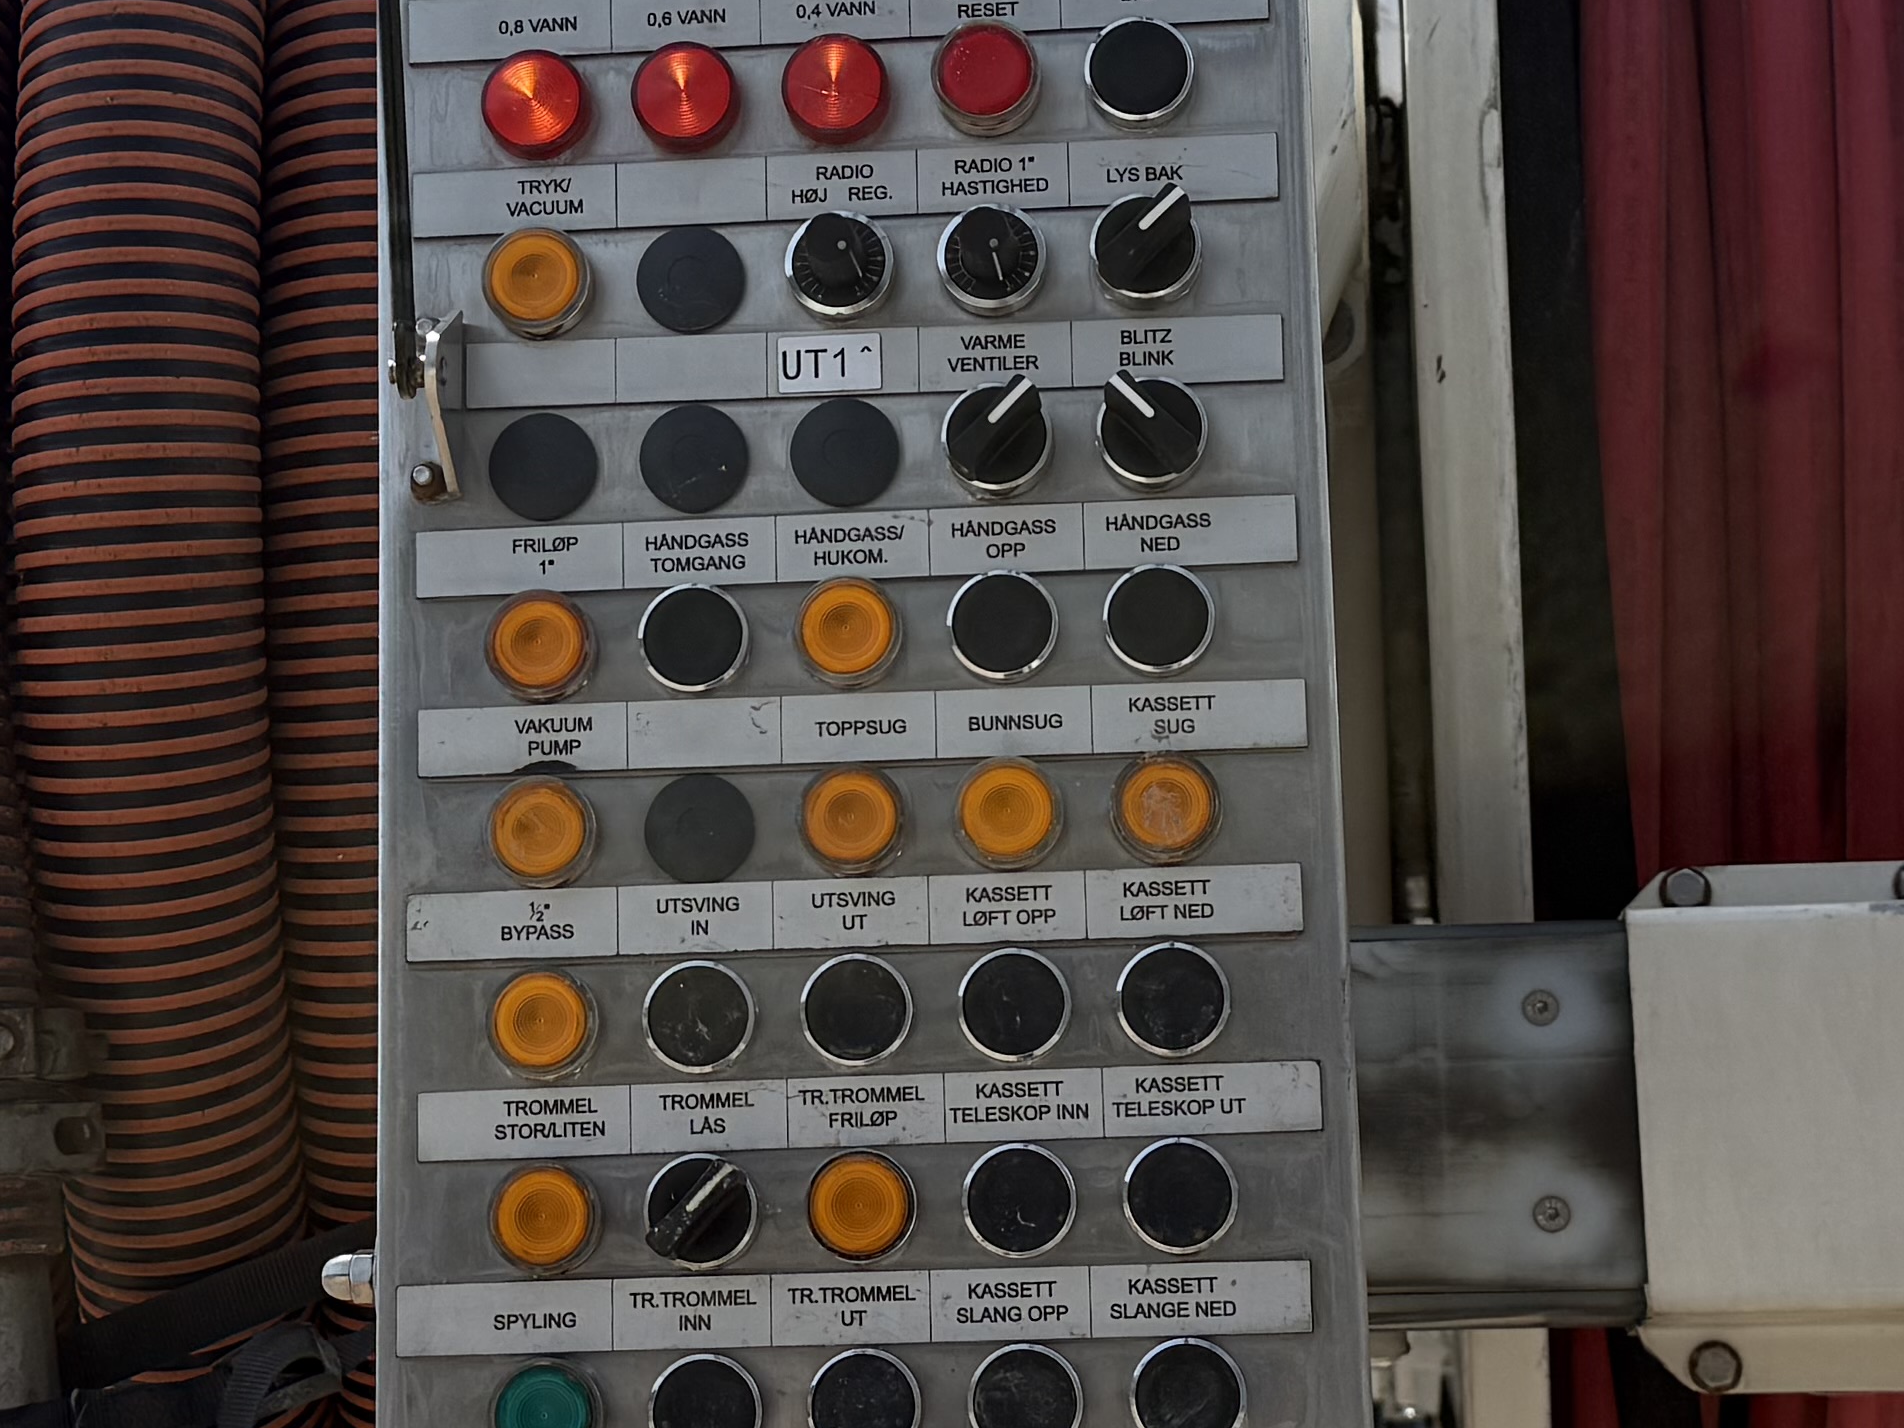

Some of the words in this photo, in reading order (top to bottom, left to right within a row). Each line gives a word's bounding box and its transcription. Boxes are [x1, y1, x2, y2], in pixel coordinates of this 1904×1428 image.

[648, 12, 671, 28] 0,6
[677, 8, 725, 24] VANN
[796, 4, 822, 20] 0,4
[826, 1, 875, 17] VANN
[958, 1, 1019, 18] RESET
[499, 20, 523, 36] 0,8
[528, 16, 577, 32] VANN
[816, 164, 873, 180] RADIO
[955, 158, 1012, 174] RADIO
[1107, 167, 1139, 183] LYS
[1145, 165, 1183, 181] BAK
[517, 178, 571, 194] TRYK/
[792, 188, 827, 204] HØJ
[849, 185, 892, 201] REG.
[942, 178, 1048, 196] HASTIGHED
[506, 199, 583, 217] VACUUM
[961, 334, 1025, 350] VARME
[1121, 329, 1172, 345] BLITZ
[948, 355, 1039, 372] VENTILER
[1120, 350, 1173, 366] BLINK
[952, 519, 1056, 538] HÅNDGASS
[1106, 513, 1211, 531] HÅNDGASS
[646, 532, 748, 551] HÅNDGASS
[795, 525, 904, 544] HÅNDGASS/
[513, 537, 578, 554] FRILØP
[986, 543, 1025, 558] OPP
[1141, 536, 1180, 552] NED
[650, 555, 745, 573] TOMGANG
[814, 548, 887, 566] HUKOM.
[1129, 695, 1216, 712] KASSETT
[515, 717, 592, 734] VAKUUM
[815, 719, 906, 737] TOPPSUG
[969, 714, 1062, 731] BUNNSUG
[1154, 719, 1195, 734] SUG
[528, 739, 581, 756] PUMP
[966, 885, 1052, 903] KASSETT
[1123, 880, 1211, 898] KASSETT
[657, 897, 739, 914] UTSVING
[812, 891, 895, 908] UTSVING
[963, 910, 1011, 926] LØFT
[1016, 909, 1056, 925] OPP
[1121, 905, 1168, 921] LØFT
[1174, 903, 1214, 919] NED
[692, 920, 708, 935] IN
[843, 914, 867, 930] UT
[501, 924, 574, 941] BYPASS
[976, 1081, 1064, 1099] KASSETT
[1136, 1075, 1224, 1093] KASSETT
[659, 1092, 754, 1110] TROMMEL
[798, 1086, 925, 1105] TR.TROMMEL
[503, 1098, 598, 1116] TROMMEL
[949, 1105, 1051, 1123] TELESKOP
[1057, 1103, 1088, 1119] INN
[1112, 1099, 1214, 1117] TELESKOP
[1220, 1098, 1246, 1114] UT
[690, 1116, 725, 1134] LÅS
[829, 1111, 897, 1128] FRILØP
[495, 1121, 605, 1140] STOR/LITEN
[788, 1285, 916, 1304] TR.TROMMEL
[968, 1281, 1057, 1299] KASSETT
[1128, 1277, 1218, 1295] KASSETT
[629, 1289, 757, 1309] TR.TROMMEL
[842, 1310, 867, 1326] UT
[957, 1305, 1021, 1323] SLANG
[1028, 1305, 1068, 1321] OPP
[1110, 1302, 1190, 1319] SLANGE
[1196, 1301, 1236, 1317] NED
[494, 1312, 576, 1330] SPYLING
[680, 1314, 711, 1331] INN
